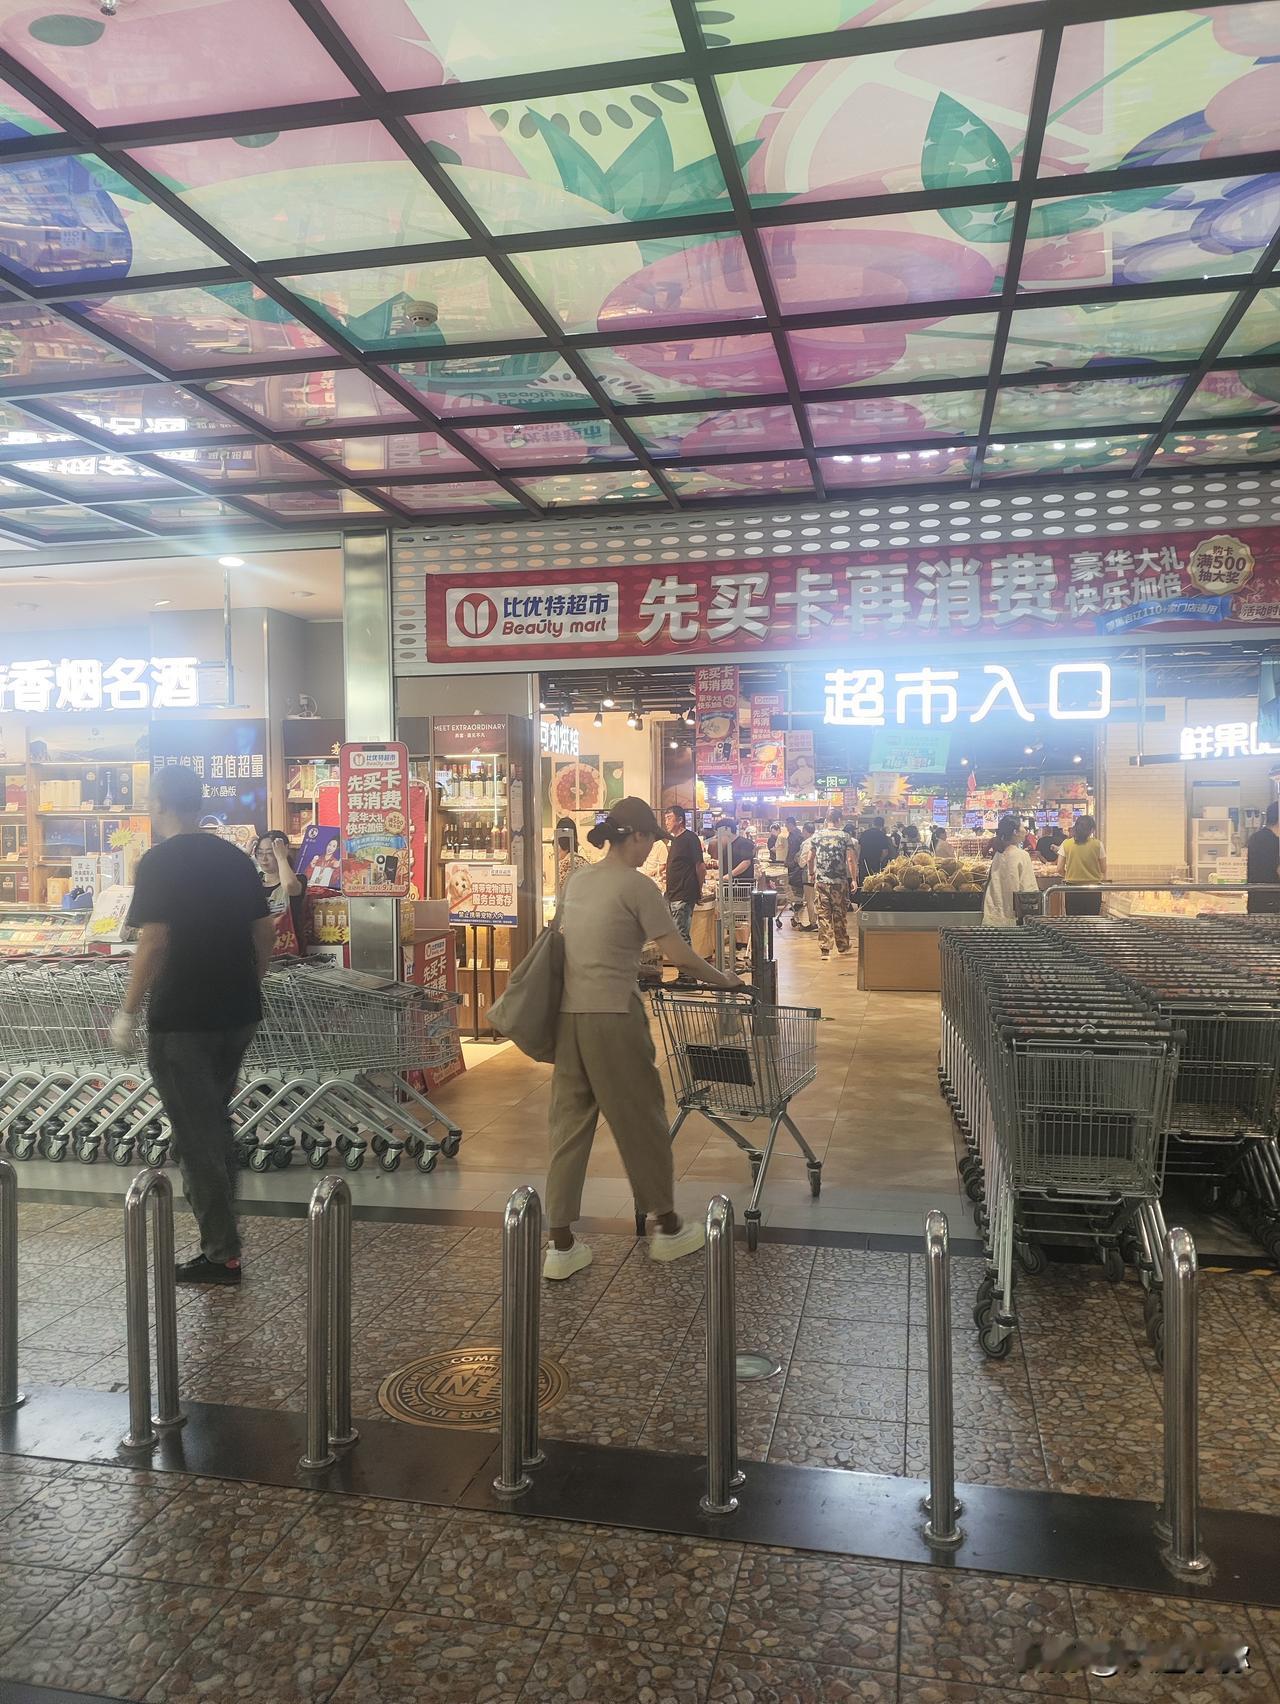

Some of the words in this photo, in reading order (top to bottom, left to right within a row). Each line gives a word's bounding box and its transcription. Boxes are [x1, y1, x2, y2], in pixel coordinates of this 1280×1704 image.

[1212, 546, 1233, 556] 购卡
[1069, 546, 1185, 583] 豪华大礼
[1197, 554, 1247, 572] 满500
[1198, 571, 1240, 585] 抽大奖
[503, 593, 610, 618] 比优特超市
[636, 552, 1059, 646] 先买卡再消费
[1064, 573, 1183, 618] 快乐加倍
[569, 617, 607, 633] mart
[698, 665, 735, 680] 先买卡
[0, 657, 199, 712] 香烟名酒
[824, 663, 1112, 726] 超市入口
[451, 723, 506, 732] EXTRAORDINARY
[211, 754, 264, 779] 超值超量
[347, 769, 402, 792] 先买卡
[347, 790, 402, 810] 再消费
